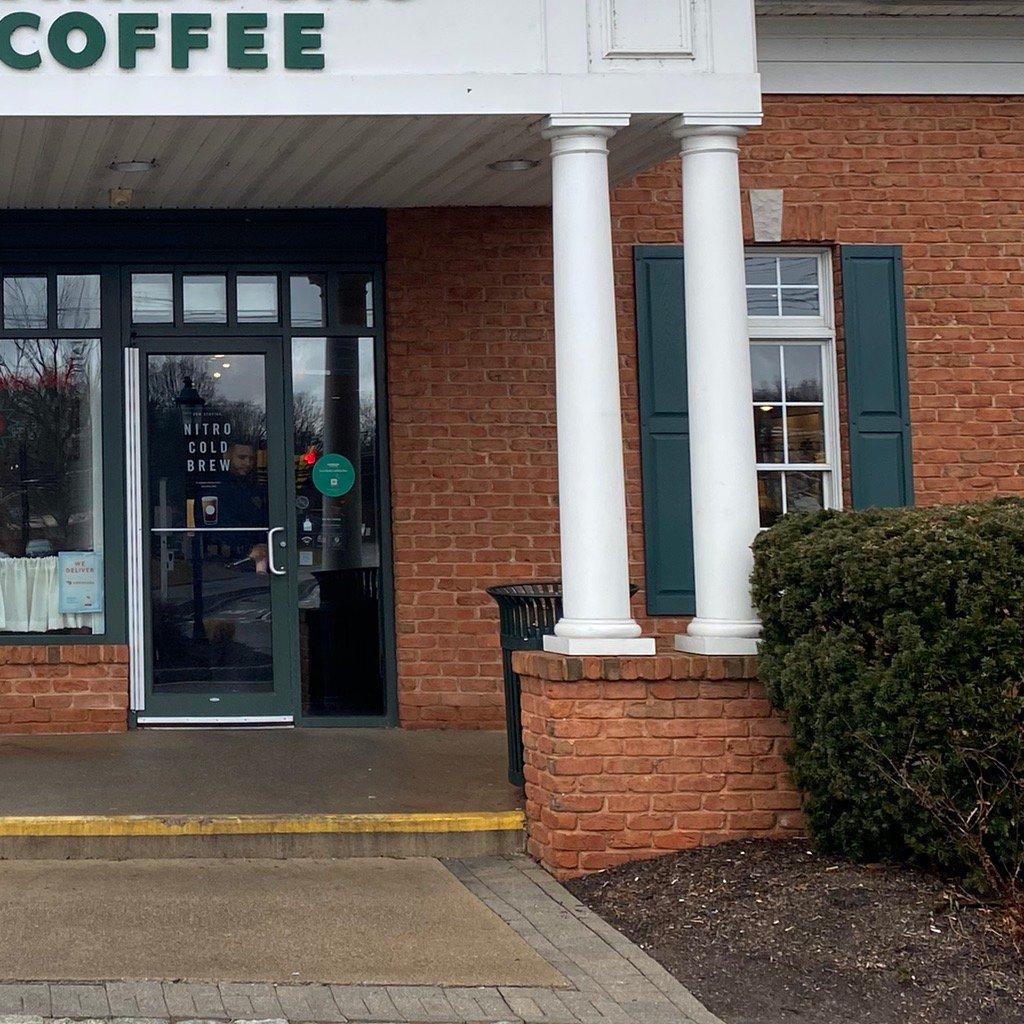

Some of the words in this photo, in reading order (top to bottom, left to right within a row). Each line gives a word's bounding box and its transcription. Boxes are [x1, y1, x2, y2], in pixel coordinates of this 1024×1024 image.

[184, 422, 231, 436] NITRO
[188, 441, 228, 454] COLD
[187, 459, 230, 472] BREW
